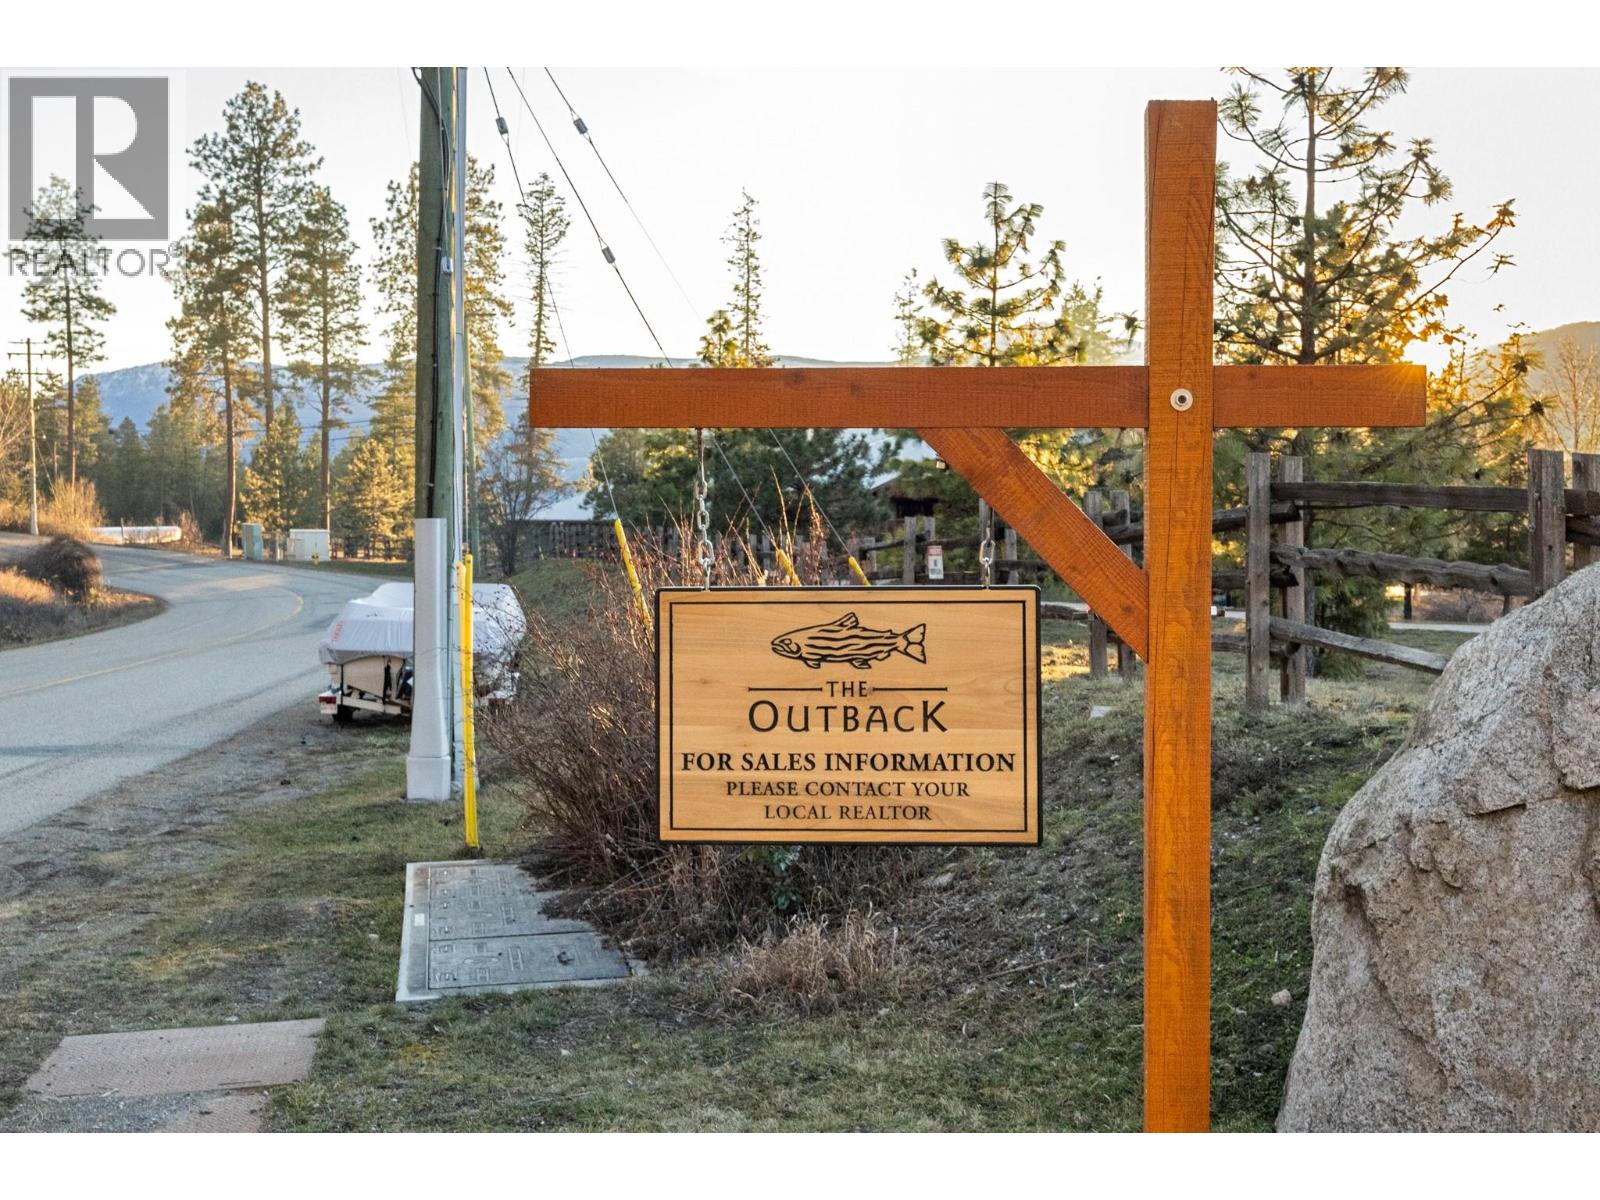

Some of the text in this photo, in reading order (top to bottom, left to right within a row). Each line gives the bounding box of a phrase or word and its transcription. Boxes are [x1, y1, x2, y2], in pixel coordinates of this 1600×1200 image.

[825, 680, 869, 698] THE
[681, 752, 1016, 772] FOR SALES INFORMATION
[726, 781, 970, 797] PLEASE CONTACT YOUR
[764, 804, 932, 821] LOCAL REALTOR
